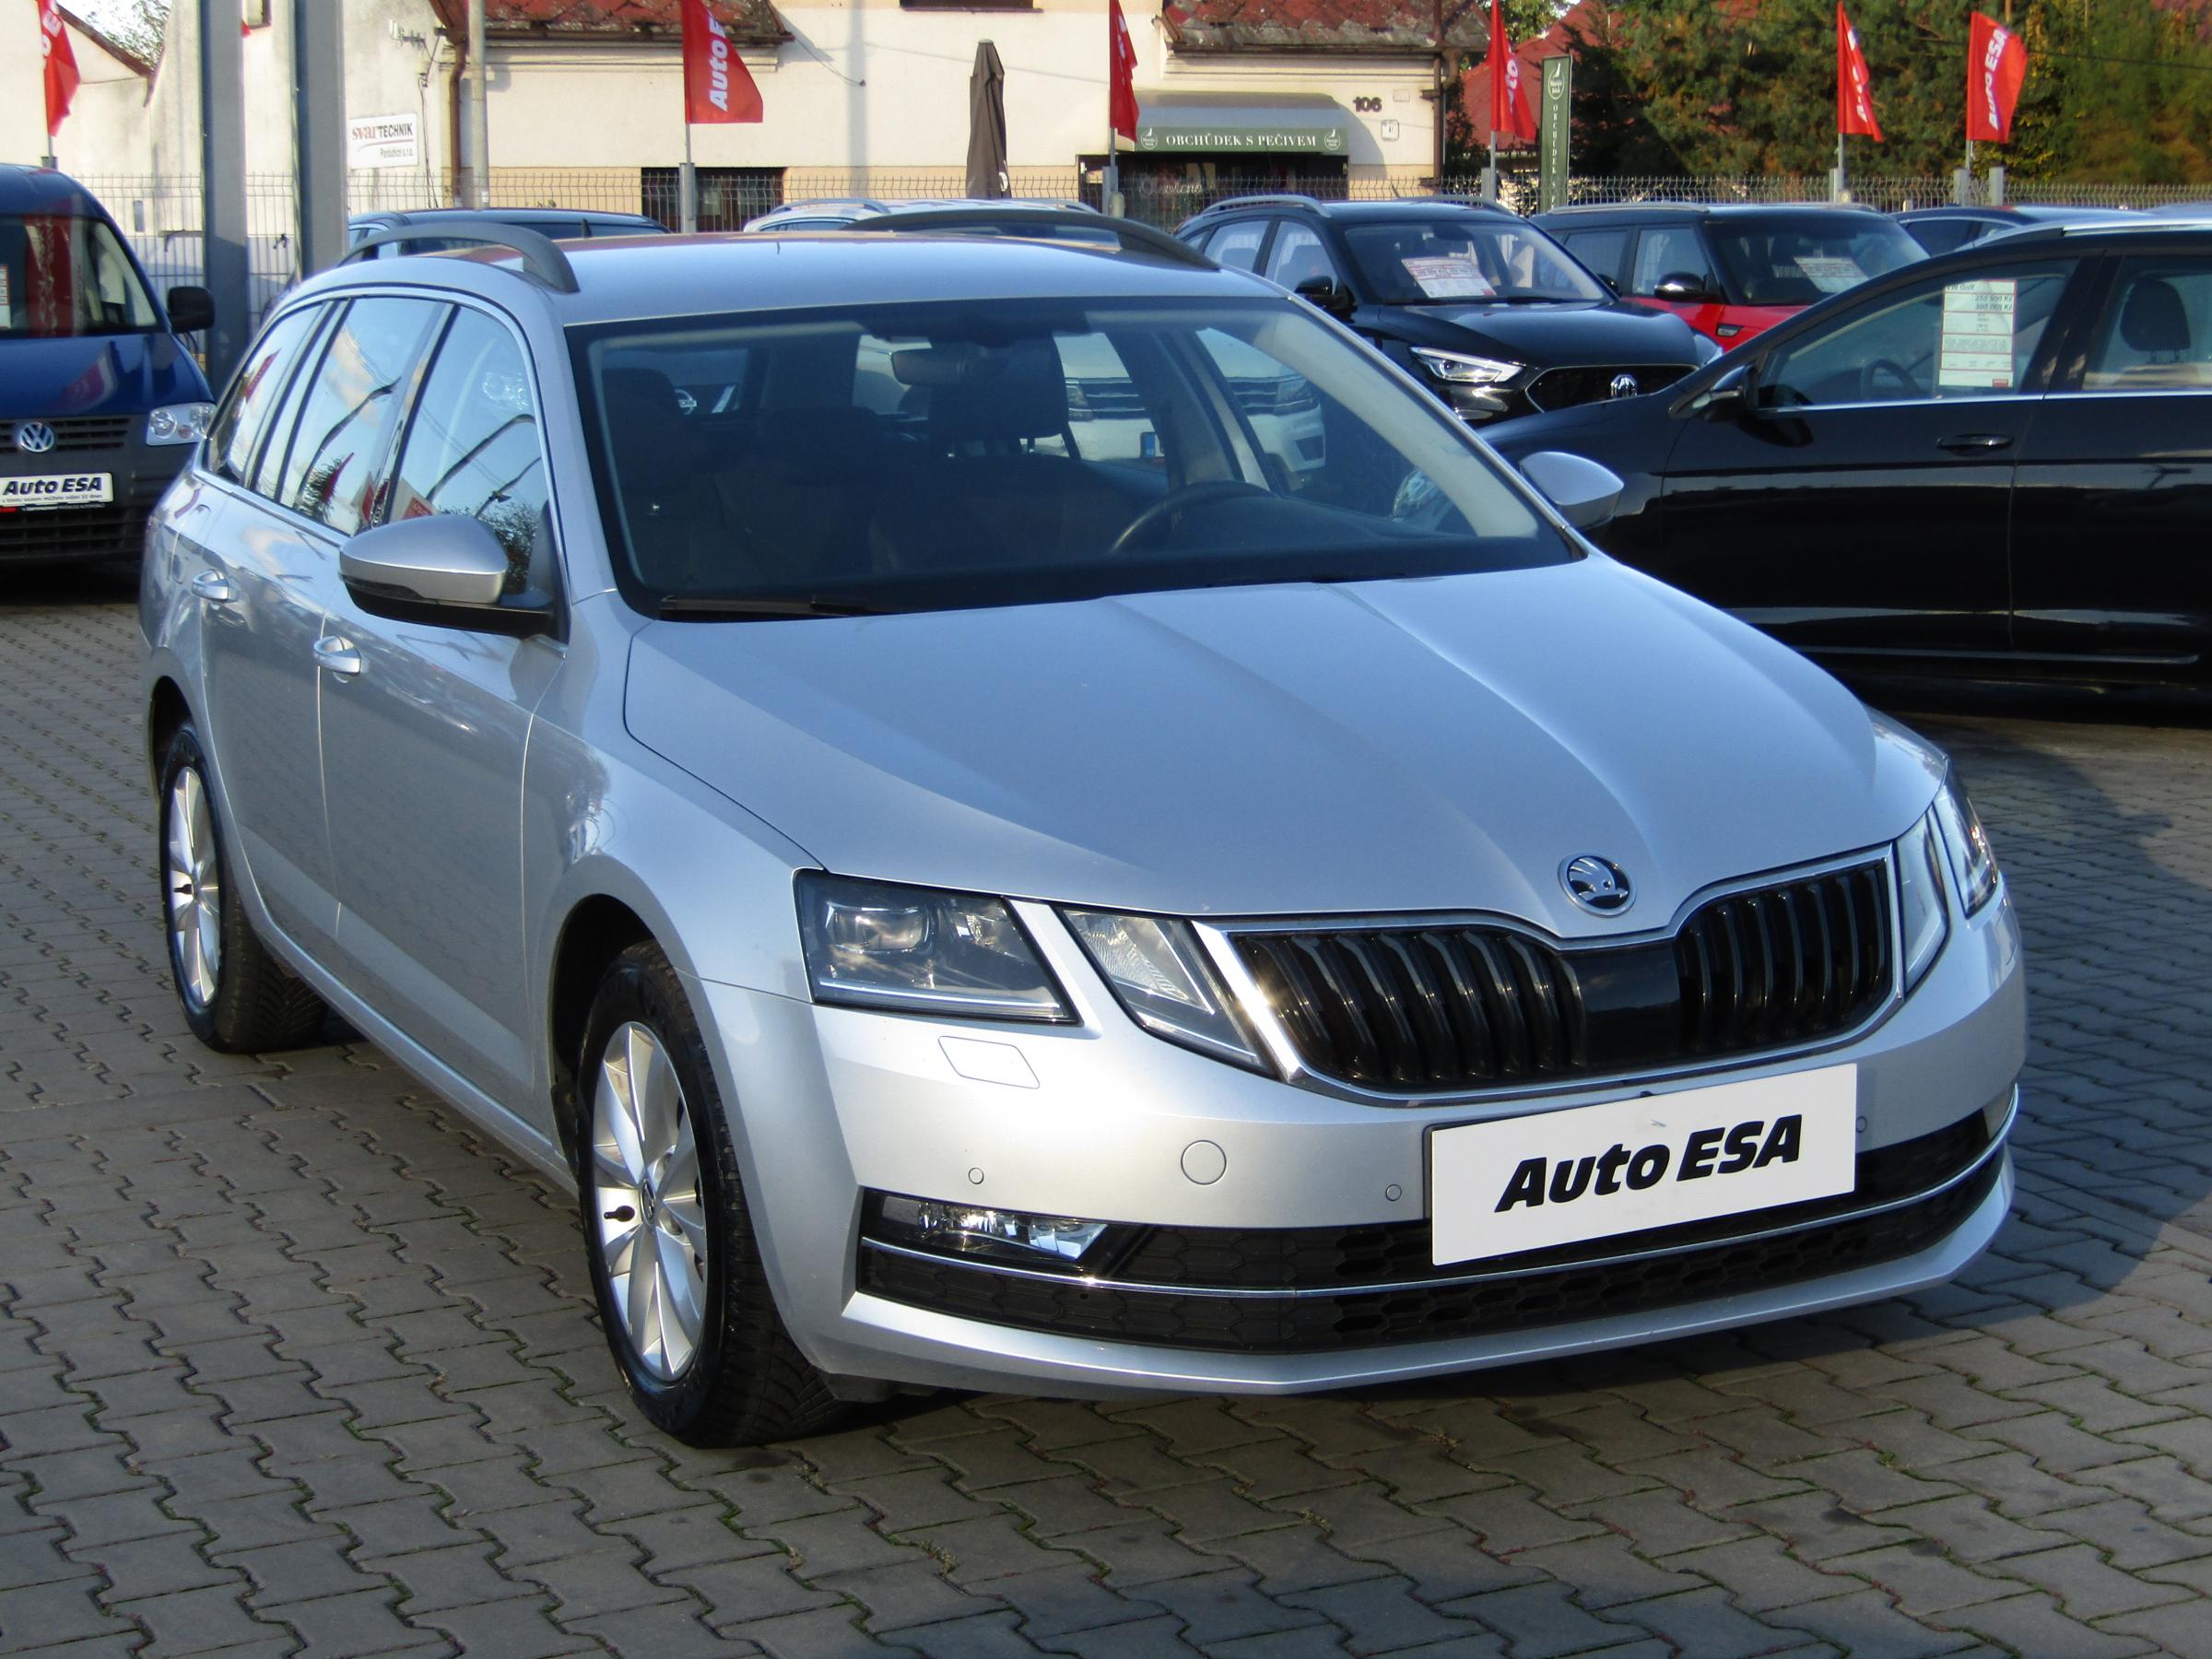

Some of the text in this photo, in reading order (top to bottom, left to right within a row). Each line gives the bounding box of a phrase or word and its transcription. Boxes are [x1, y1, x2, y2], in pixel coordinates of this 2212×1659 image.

[1984, 29, 2007, 72] ESA
[710, 40, 728, 112] Auto
[1353, 96, 1382, 112] 106
[1166, 133, 1242, 147] OBCHŮDEK
[1245, 135, 1253, 147] S
[1258, 134, 1317, 147] PEČIVEM
[2, 477, 102, 495] Auto ESA
[1494, 1114, 1803, 1214] Auto ESA
